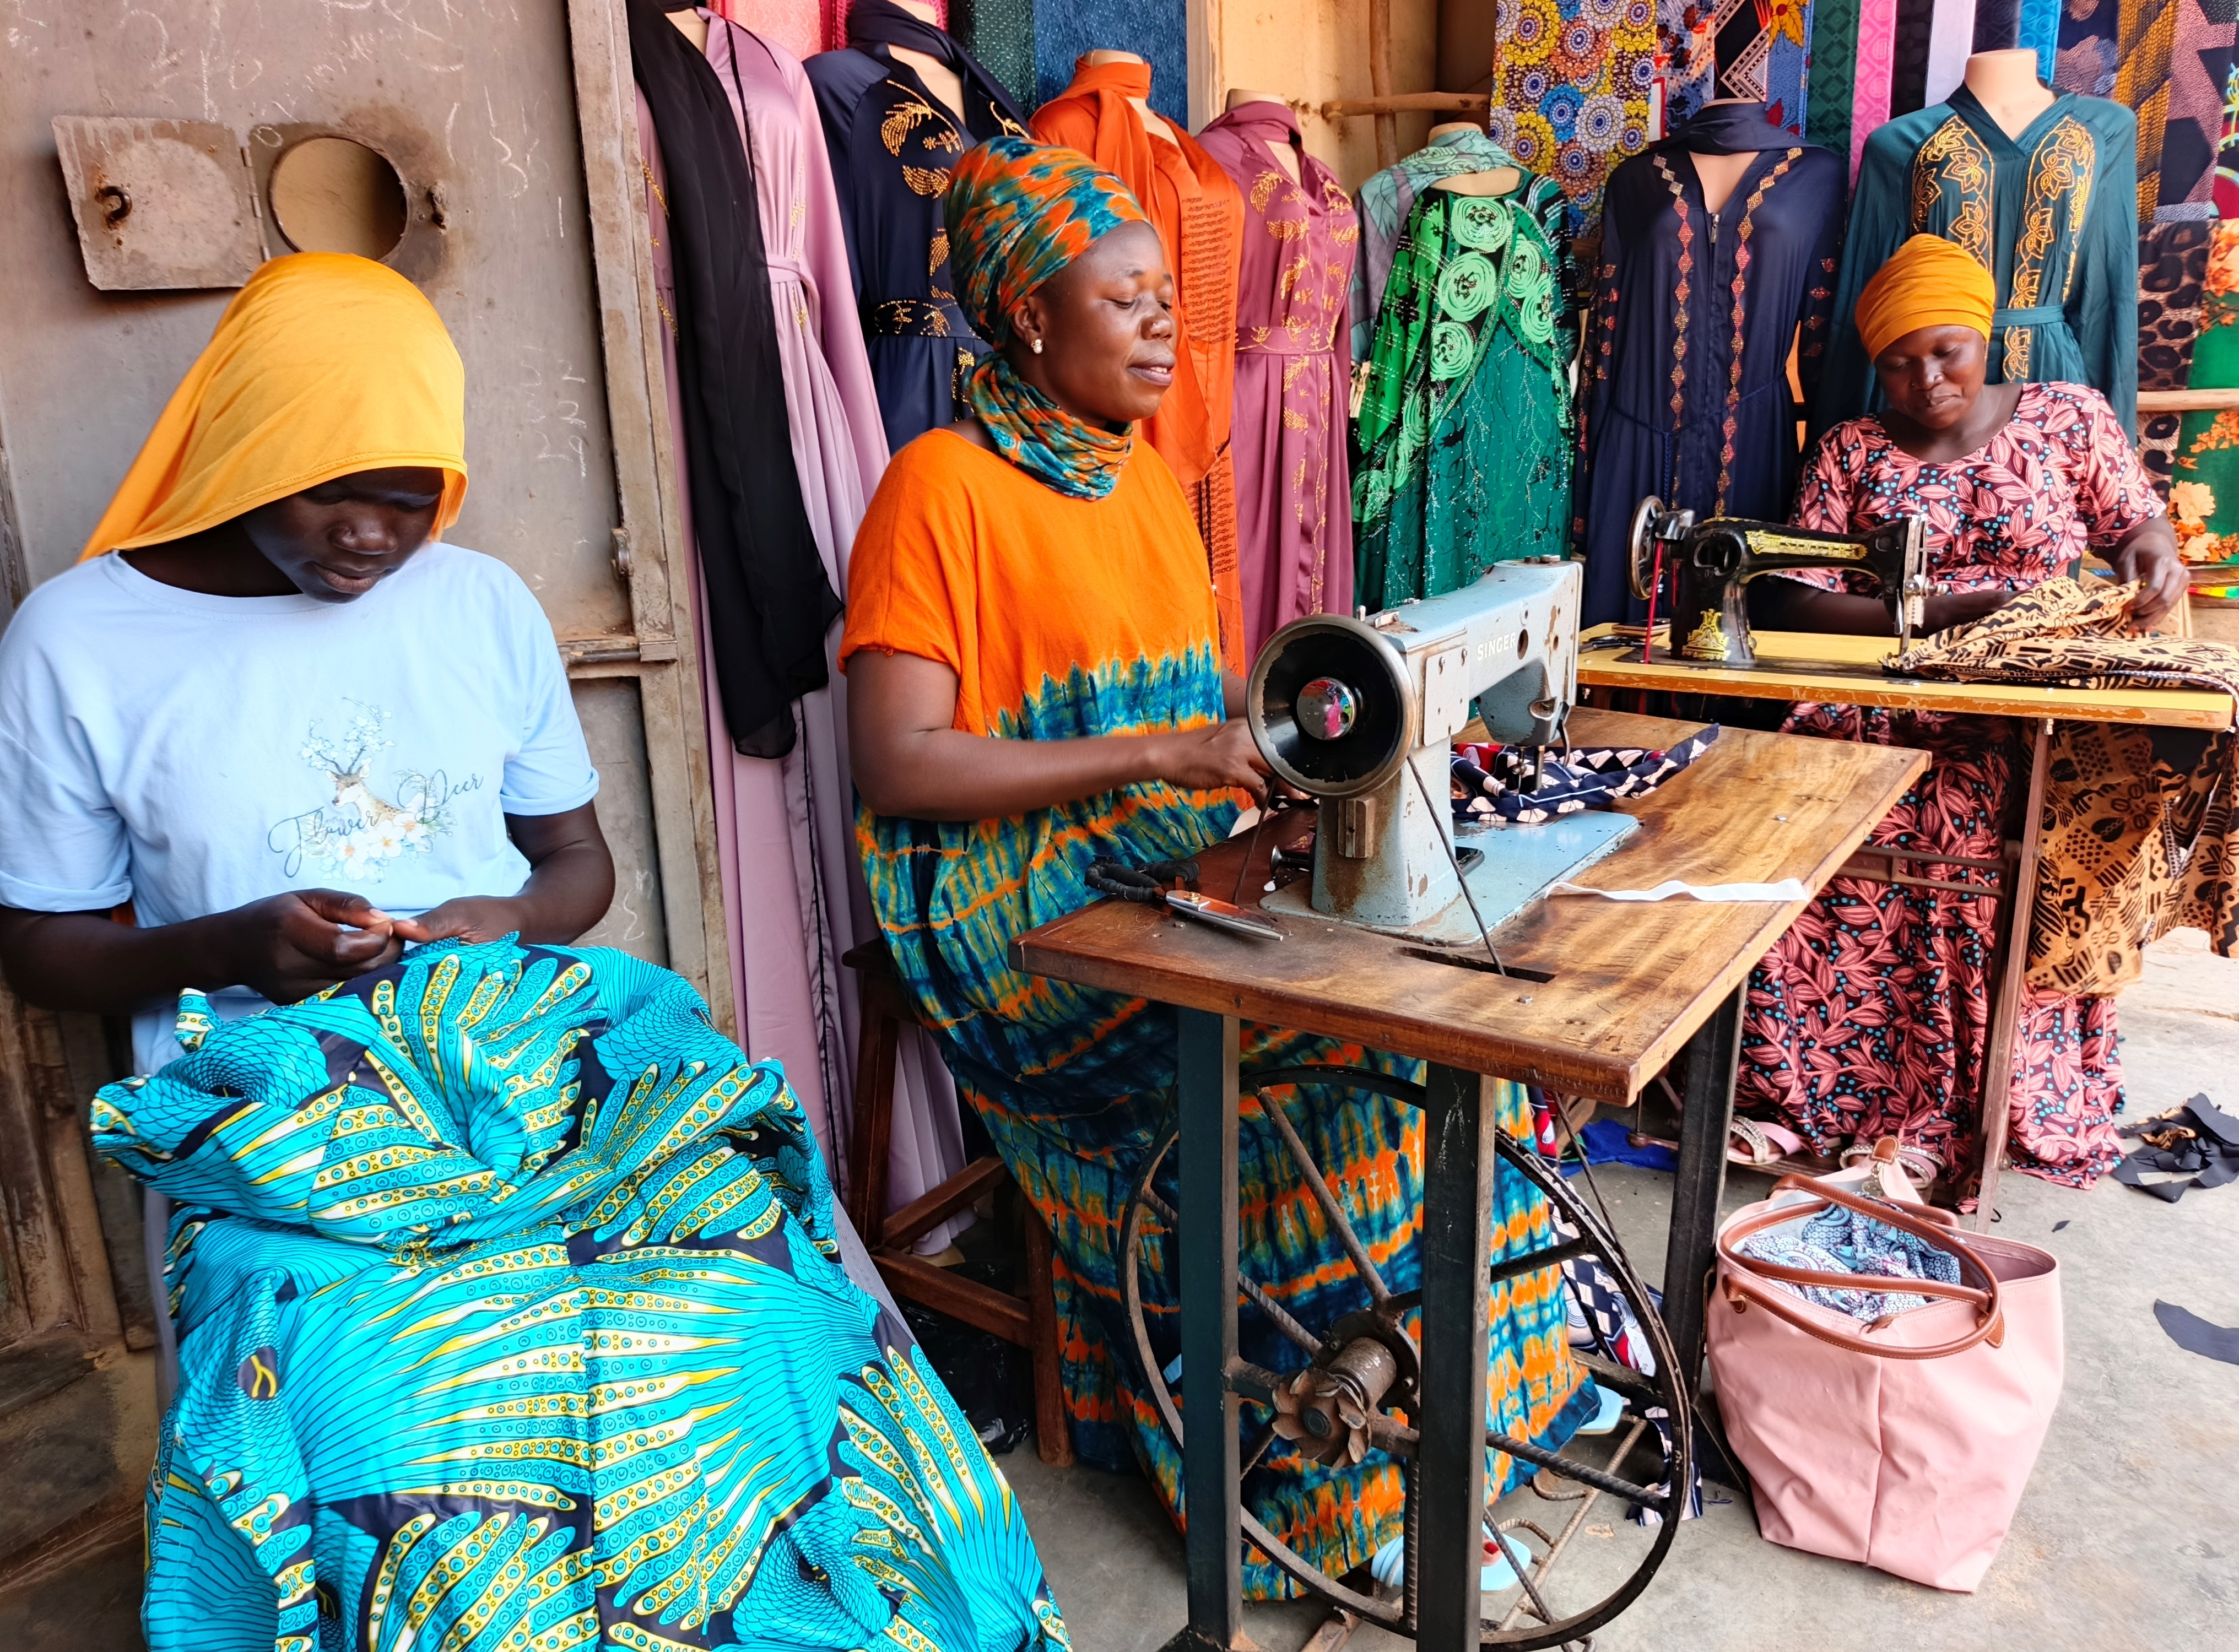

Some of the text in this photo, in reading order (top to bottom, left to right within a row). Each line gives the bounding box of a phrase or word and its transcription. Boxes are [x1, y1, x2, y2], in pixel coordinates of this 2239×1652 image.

[1784, 540, 1847, 554] SINGER
[1477, 632, 1517, 662] SINGER
[267, 769, 484, 878] Flower Deer
